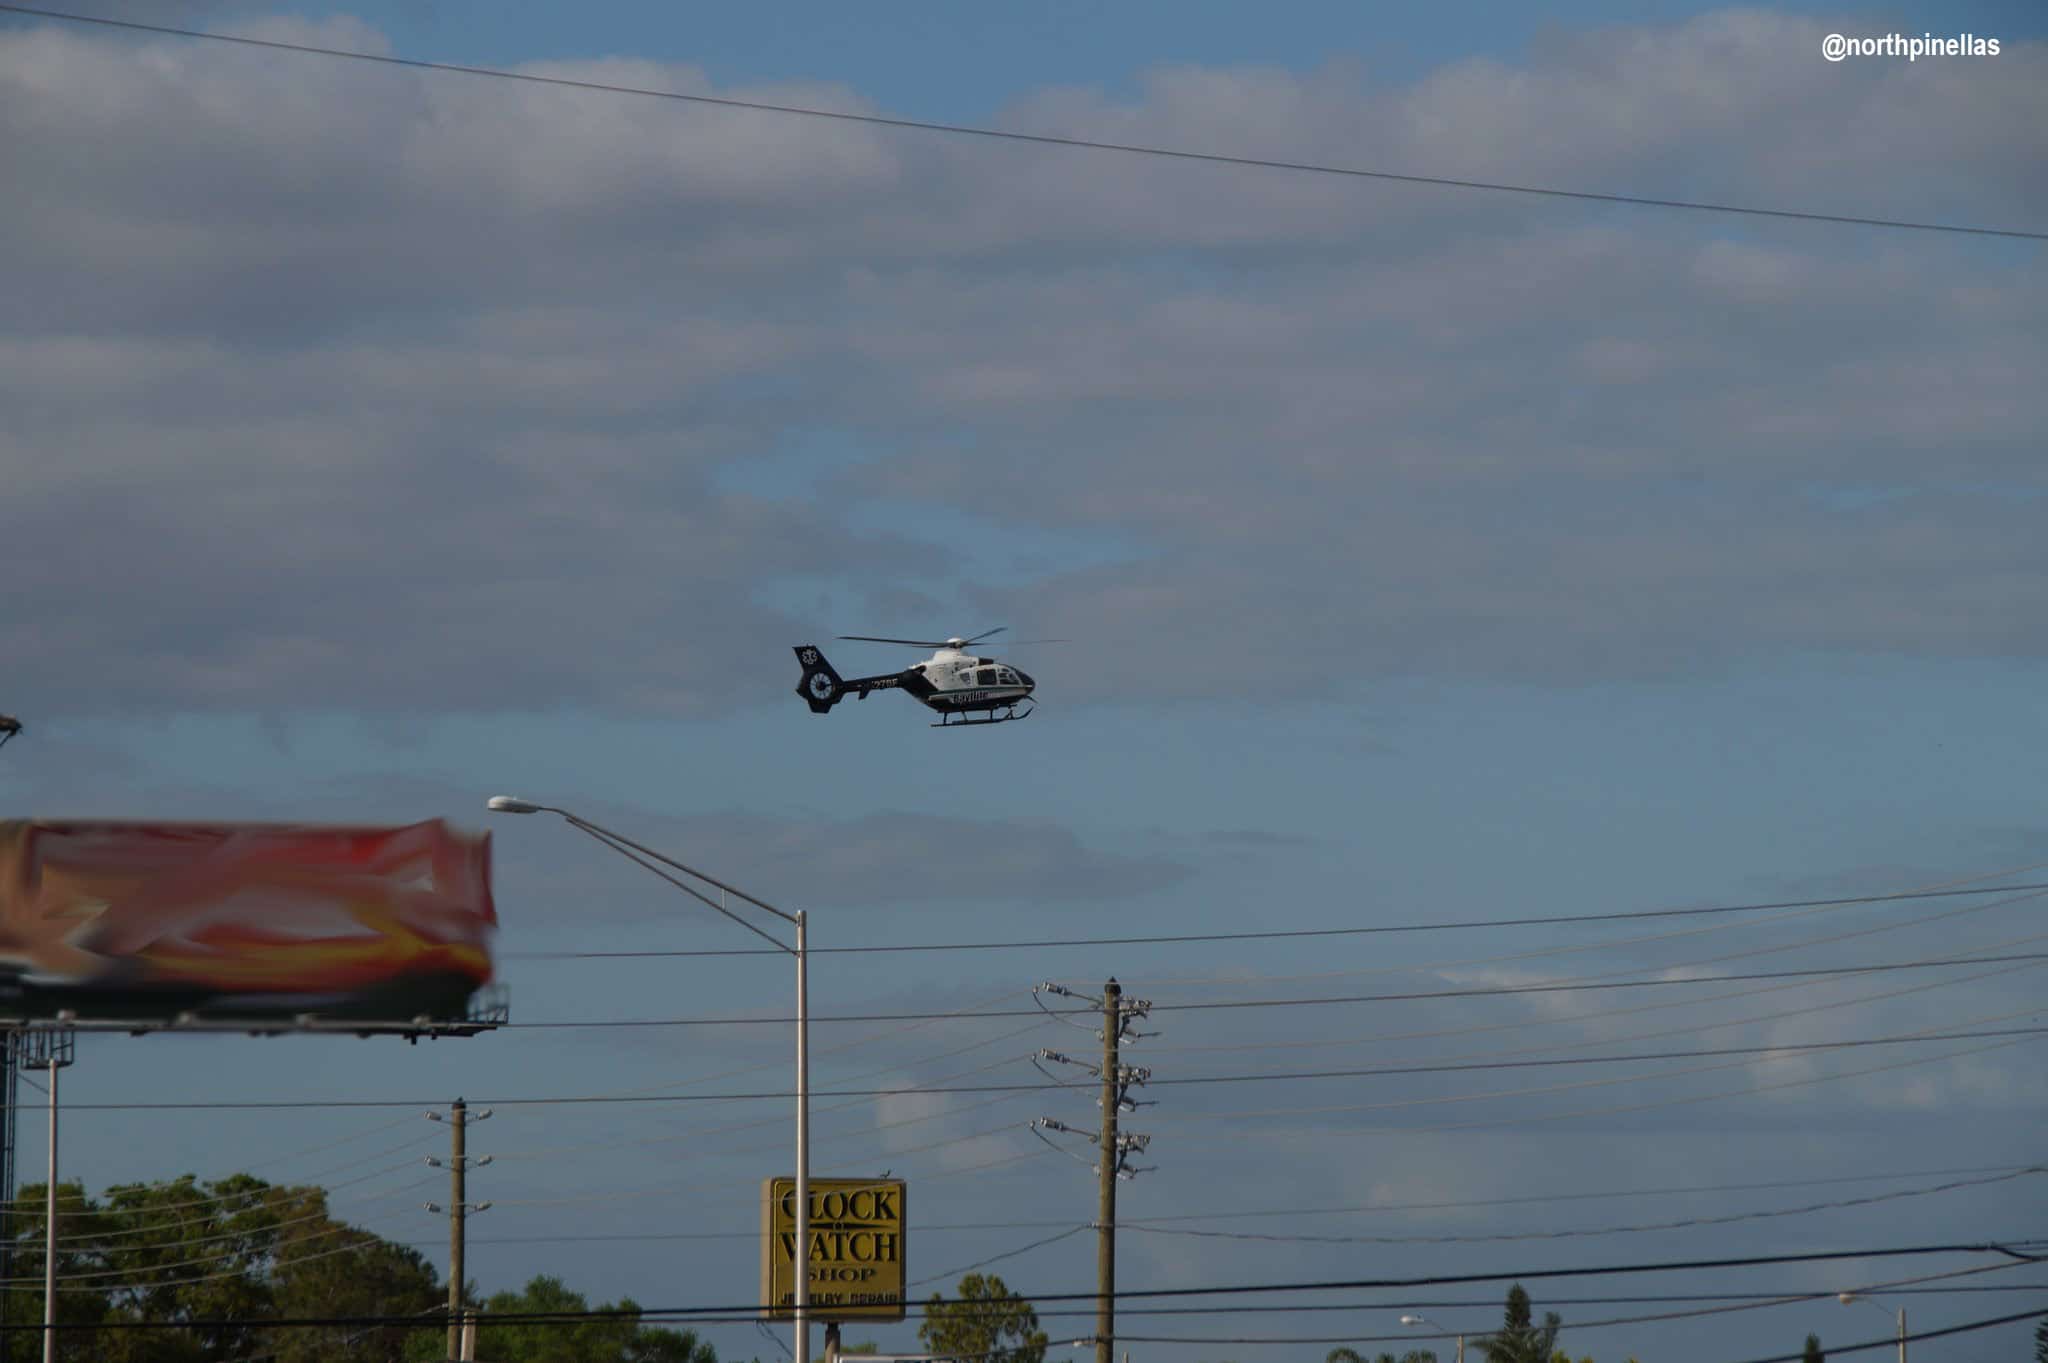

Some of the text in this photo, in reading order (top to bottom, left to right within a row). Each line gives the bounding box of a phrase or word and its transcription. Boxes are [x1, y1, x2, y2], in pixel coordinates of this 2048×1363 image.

[782, 1190, 897, 1220] CLOCK
[807, 1268, 876, 1281] SHOP
[781, 1293, 842, 1305] JEELRY
